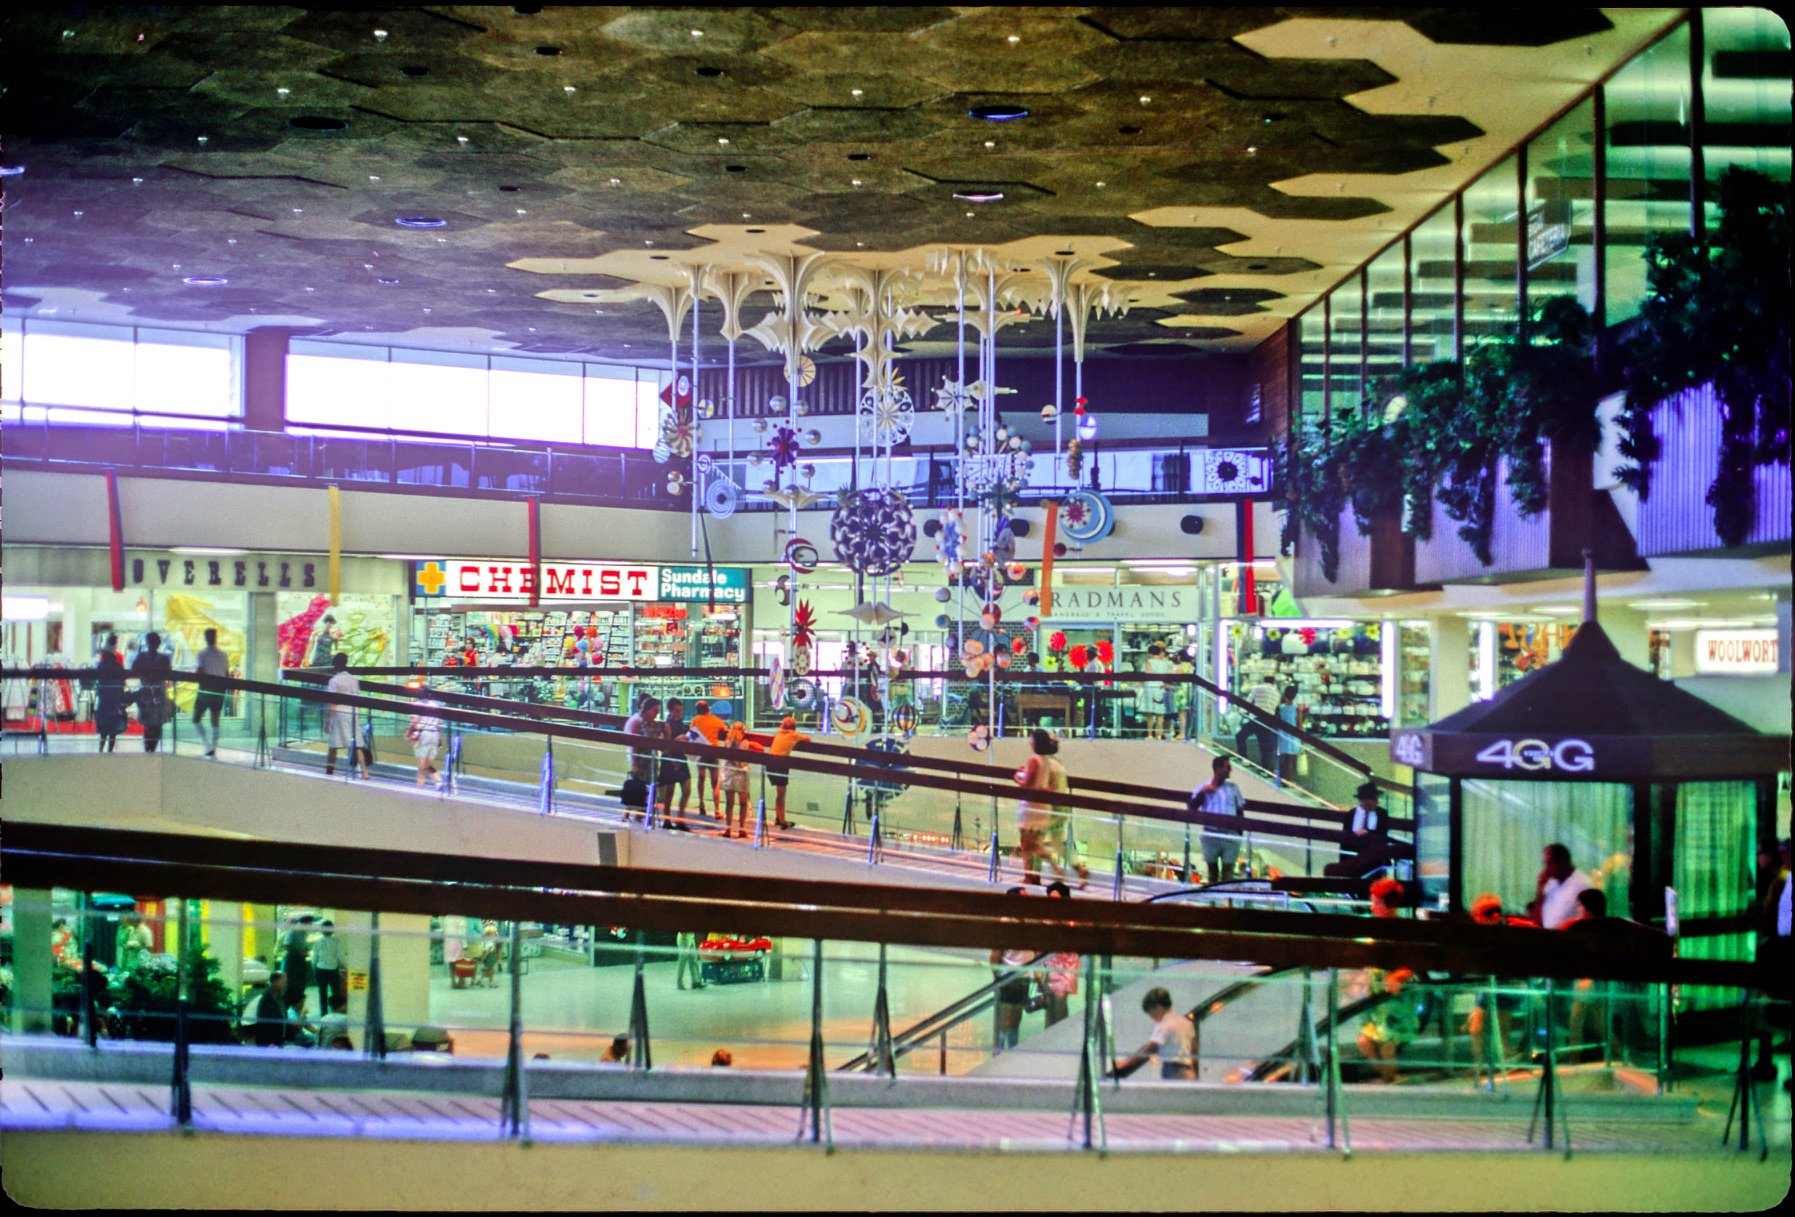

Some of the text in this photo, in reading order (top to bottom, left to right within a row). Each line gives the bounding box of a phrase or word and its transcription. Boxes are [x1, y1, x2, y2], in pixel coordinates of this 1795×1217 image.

[661, 568, 727, 584] Sundale
[661, 583, 745, 602] Pharmacy
[1036, 591, 1181, 608] RADMANS
[1476, 739, 1595, 771] 4GG
